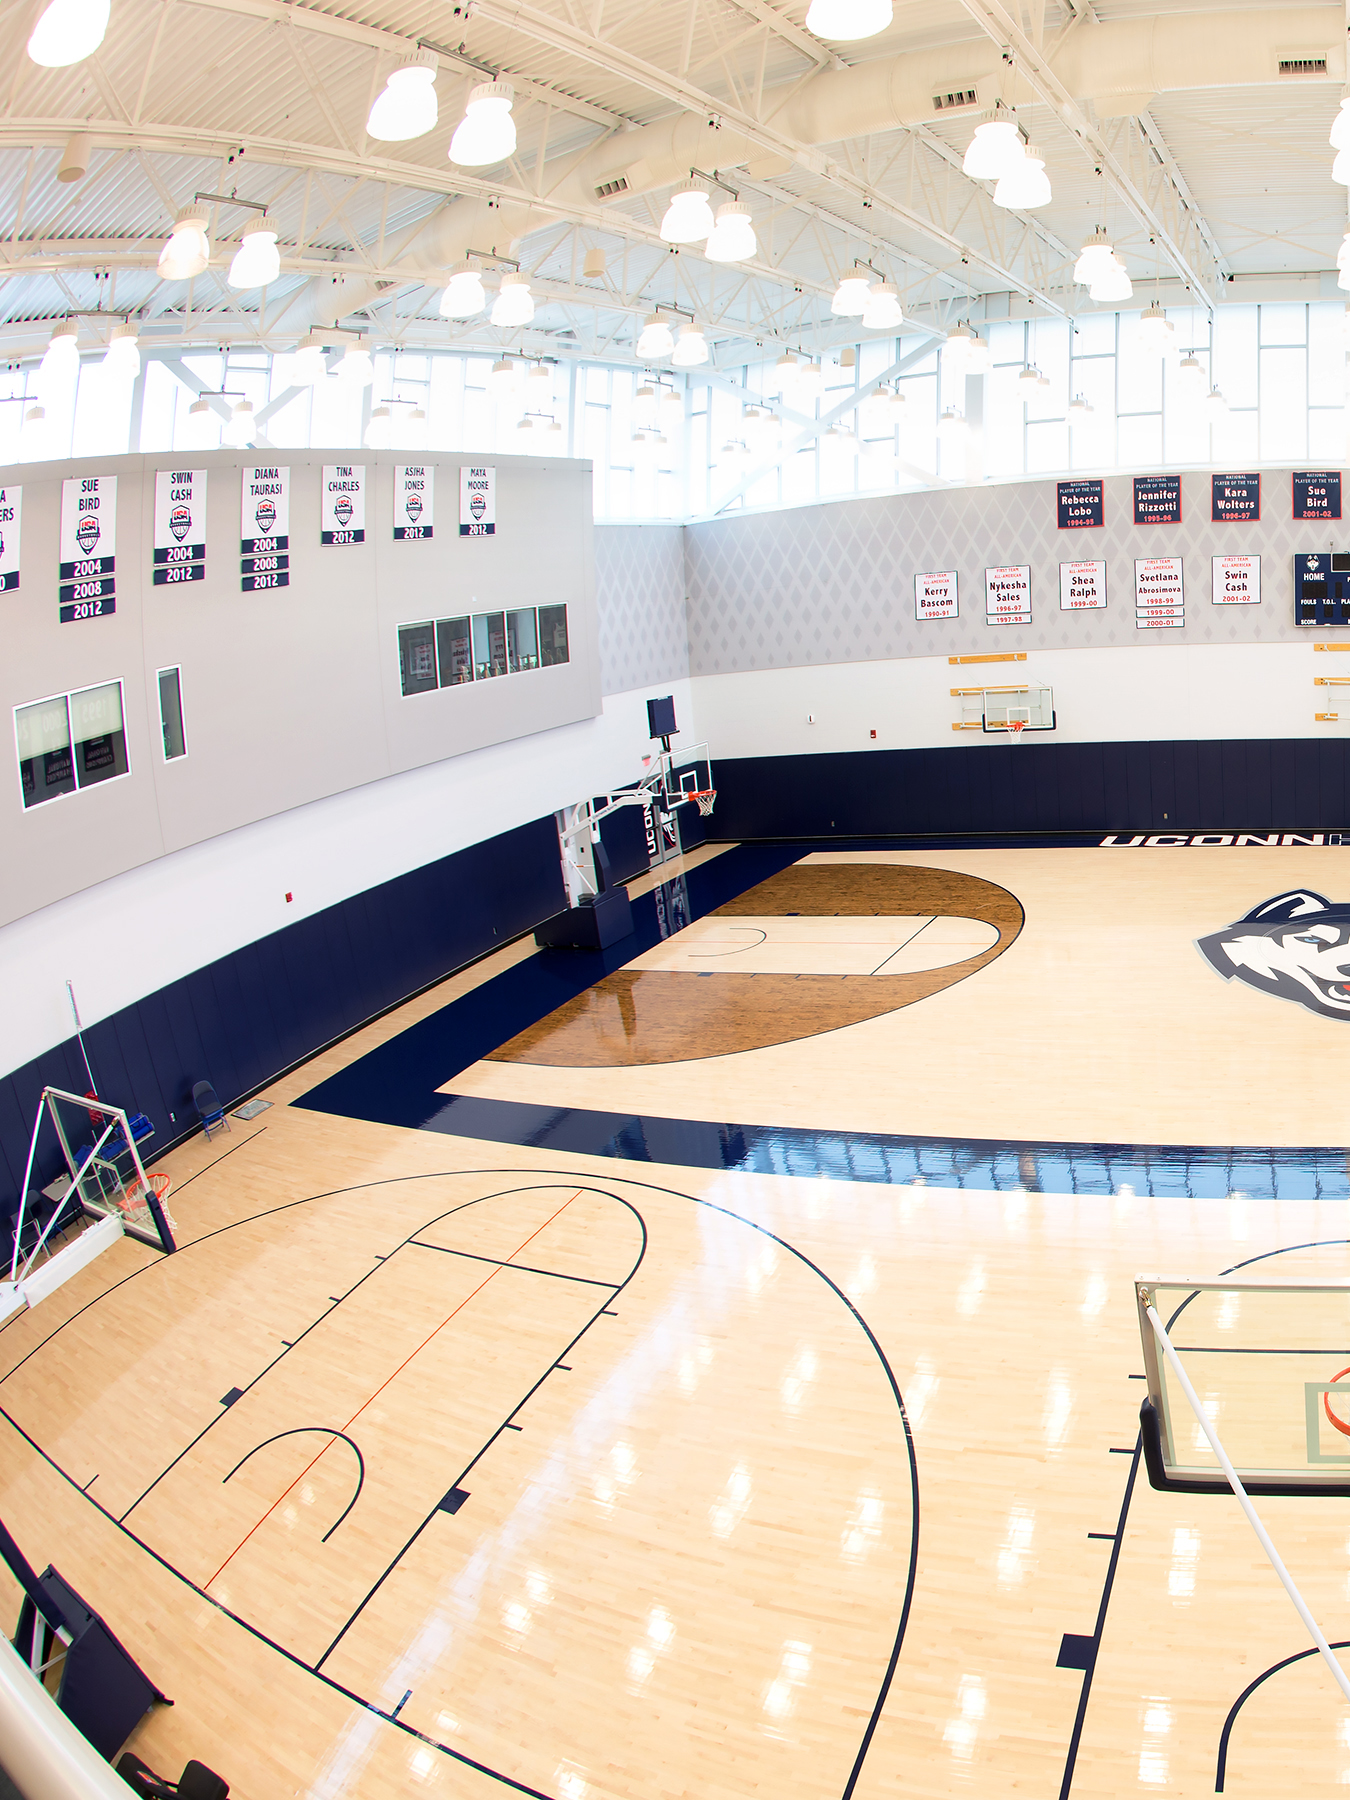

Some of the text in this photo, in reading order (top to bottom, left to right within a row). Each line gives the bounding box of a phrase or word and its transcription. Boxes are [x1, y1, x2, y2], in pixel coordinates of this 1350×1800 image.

[255, 468, 279, 480] DIANA
[337, 467, 352, 477] TINA
[471, 469, 486, 477] MAYA
[171, 472, 193, 484] SWIN
[82, 479, 99, 492] SUE
[250, 484, 282, 495] TAURASI
[328, 481, 360, 491] CHARLES
[405, 481, 424, 490] JONES
[468, 481, 489, 490] MOORE
[1308, 486, 1326, 495] Sue
[171, 489, 192, 501] CASH
[1138, 491, 1177, 501] Jennifer
[1225, 488, 1247, 497] Kara
[79, 497, 100, 511] BIRD
[1062, 496, 1099, 505] Rebecca
[1218, 500, 1255, 509] Wolters
[1307, 498, 1327, 507] Bird
[260, 503, 272, 513] USA
[1069, 507, 1091, 517] Lobo
[1139, 502, 1176, 512] Rizzotti
[174, 510, 187, 520] USA
[81, 520, 96, 531] USA
[469, 525, 487, 535] 2012
[333, 532, 354, 543] 2012
[404, 528, 424, 538] 2012
[253, 538, 277, 551] 2004
[167, 547, 193, 561] 2004
[74, 561, 102, 576] 2004
[253, 558, 277, 571] 2008
[167, 567, 193, 582] 2012
[1140, 573, 1179, 582] Svetlana
[1225, 570, 1248, 579] Swin
[254, 575, 278, 588] 2012
[1072, 576, 1094, 585] Shea
[74, 581, 102, 599] 2008
[990, 581, 1027, 591] Nykesha
[1139, 586, 1181, 594] Abrosimova
[1225, 582, 1247, 591] Cash
[925, 587, 948, 597] Kerry
[1070, 588, 1096, 598] Ralph
[997, 593, 1020, 602] Sales
[921, 599, 953, 607] Bascom
[74, 602, 102, 619] 2012
[1099, 834, 1324, 848] UCONN
